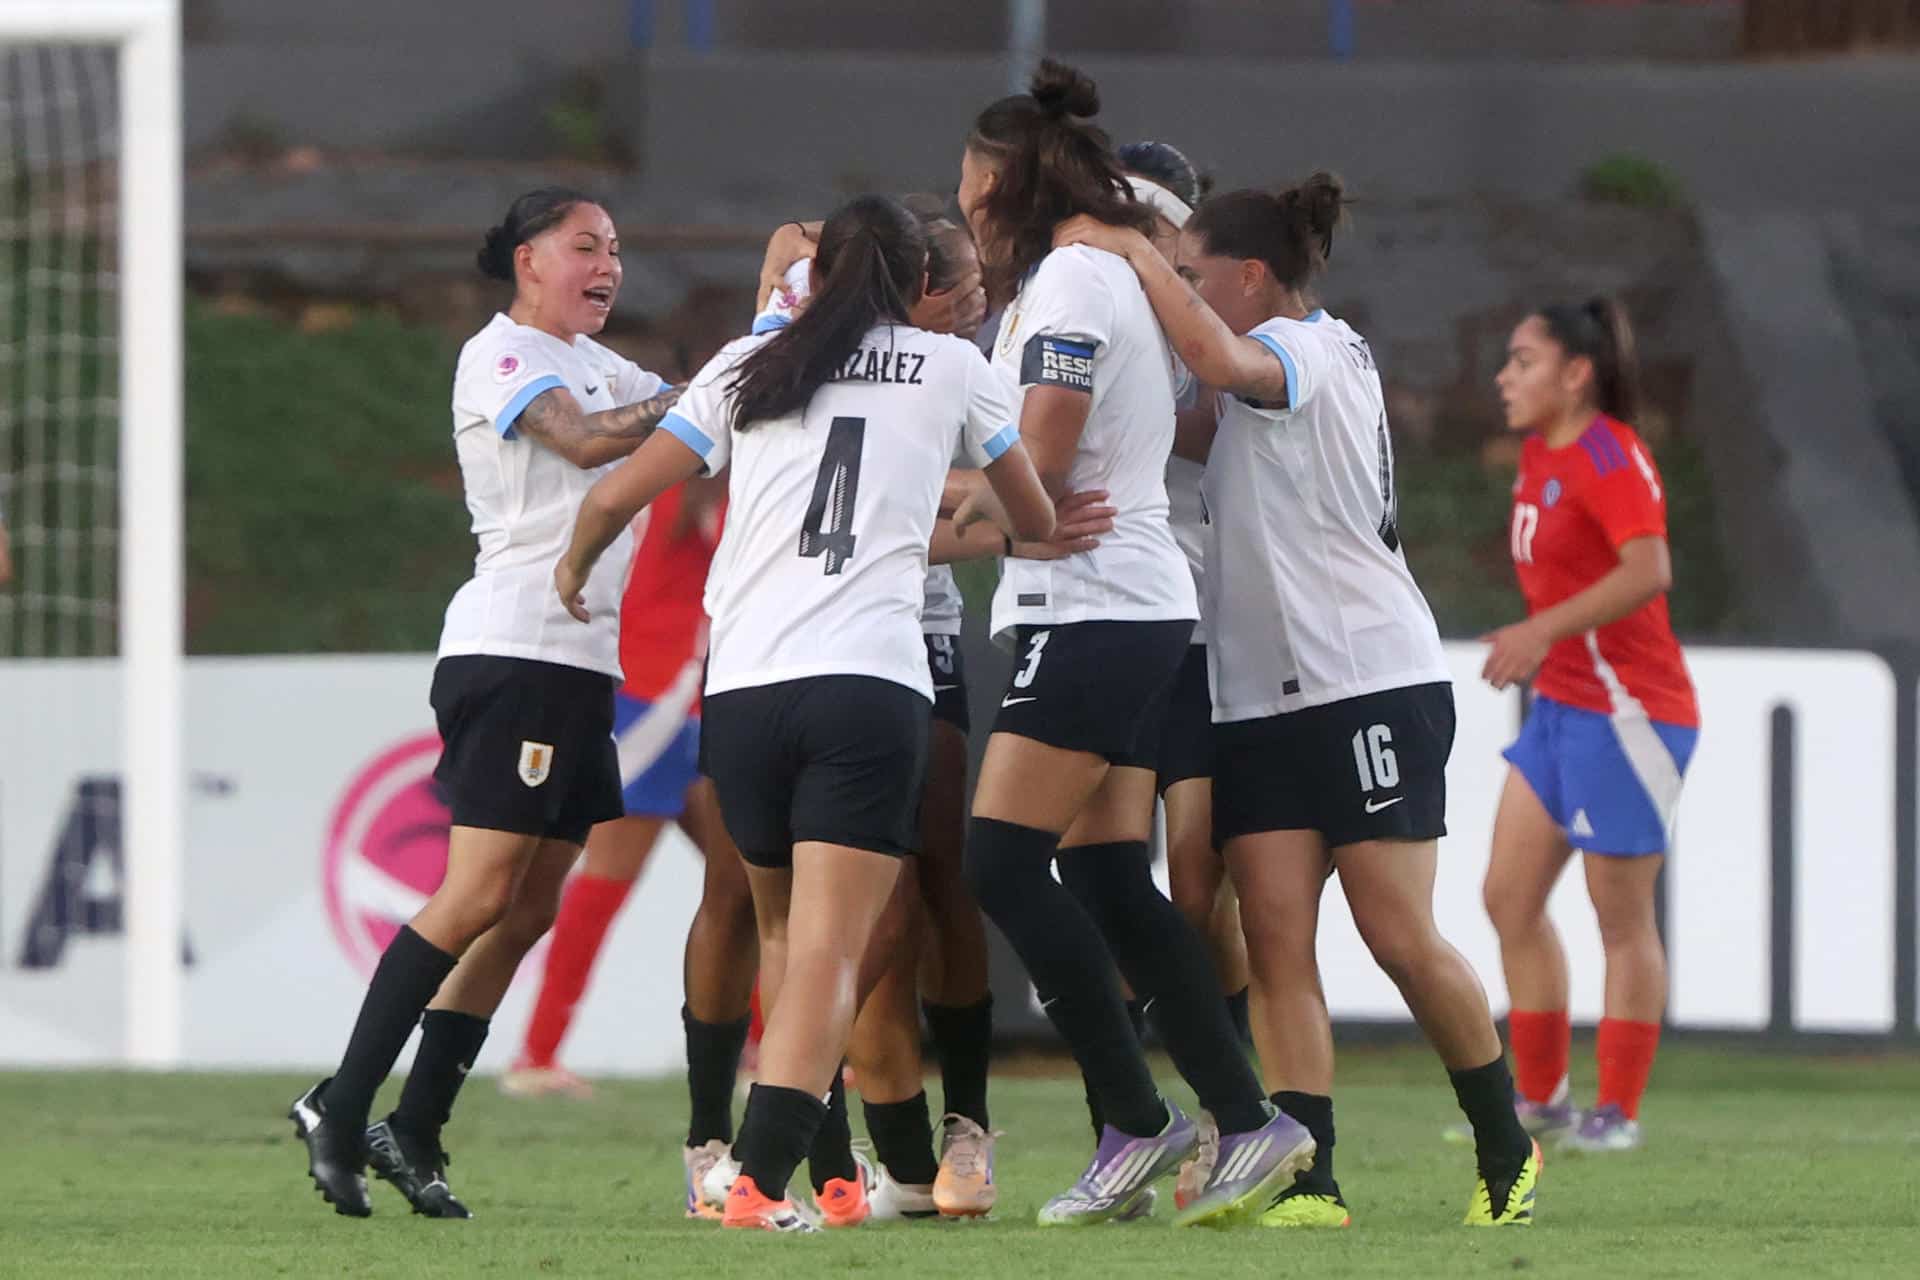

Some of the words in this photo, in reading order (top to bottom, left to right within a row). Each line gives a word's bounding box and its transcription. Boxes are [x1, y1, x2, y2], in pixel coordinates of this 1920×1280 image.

[833, 346, 925, 384] ZÁLEZ
[1042, 341, 1056, 351] EL
[1042, 368, 1058, 380] ES
[799, 416, 866, 575] 4
[1014, 630, 1051, 688] 3
[1352, 723, 1400, 791] 16
